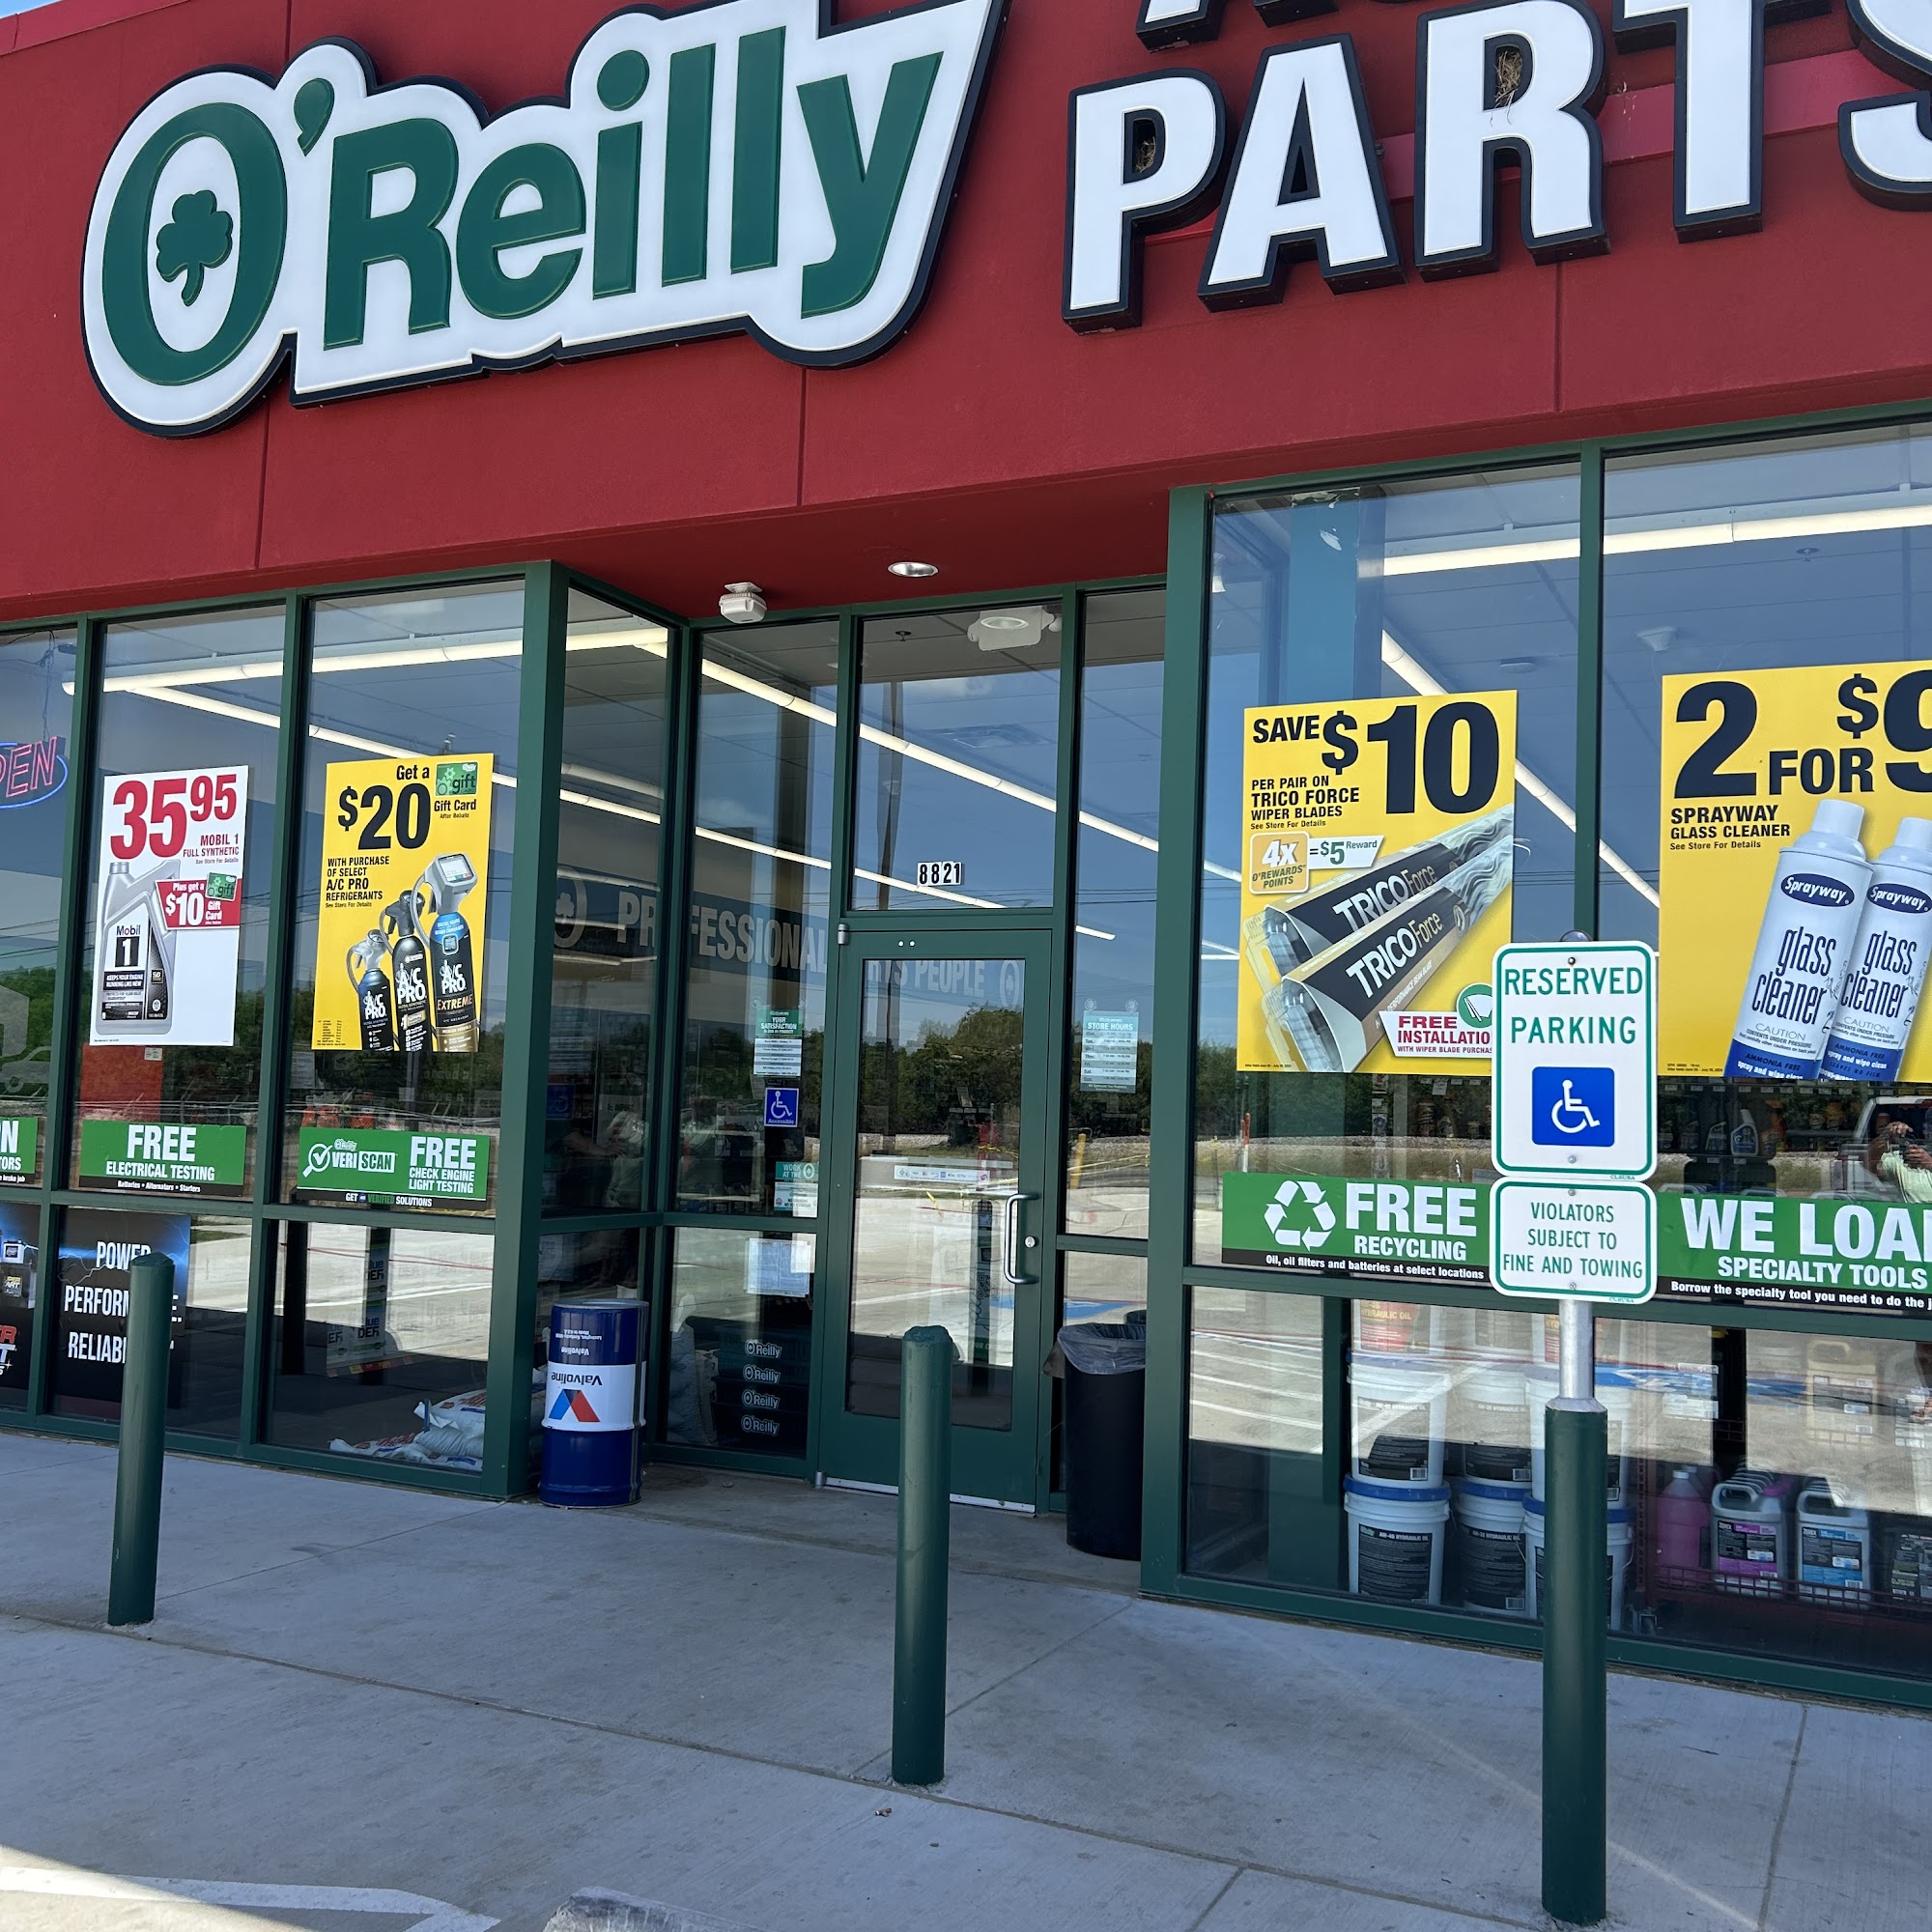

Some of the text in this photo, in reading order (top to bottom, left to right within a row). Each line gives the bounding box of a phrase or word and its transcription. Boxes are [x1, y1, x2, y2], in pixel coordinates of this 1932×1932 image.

[102, 26, 943, 386] O'Reilly
[1253, 715, 1321, 744] SAVE
[1674, 680, 1874, 799] 2 FOR
[396, 764, 430, 783] Get a
[1252, 775, 1329, 791] PER PAIR ON
[434, 799, 477, 812] Gift Card
[1252, 787, 1360, 809] TRICO FORCE
[338, 782, 432, 851] $20
[1251, 805, 1343, 821] WIPER BLADES
[1671, 804, 1778, 824] SPRAYWAY
[1300, 819, 1326, 828] Details
[1670, 823, 1790, 839] GLASS CLEANER
[200, 833, 239, 846] MOBIL 1
[1346, 840, 1378, 849] Reward
[1670, 839, 1761, 850] See Store For Details
[183, 846, 240, 858] FULL SYNTHETIC
[327, 855, 389, 867] WITH PURCHASE
[327, 867, 367, 878] OF SELECT
[919, 862, 961, 885] 8821
[1252, 865, 1304, 882] O'REWARDS
[173, 882, 187, 892] Plus
[326, 878, 369, 892] A/C PRO
[1263, 875, 1293, 890] POINTS
[1784, 875, 1847, 907] Sprayway
[326, 890, 383, 901] REFRIGERANTS
[1870, 885, 1927, 914] Sprayway
[165, 893, 205, 926] $10
[205, 910, 222, 921] Card
[117, 924, 141, 936] Mobil
[123, 938, 131, 966] 1
[1777, 926, 1836, 976] glass
[1861, 929, 1917, 976] glass
[441, 978, 467, 994] PRO
[1504, 966, 1643, 996] RESERVED
[397, 983, 426, 1005] PRO
[437, 994, 473, 1010] EXTREME
[1751, 973, 1828, 1025] cleaner
[1840, 970, 1909, 1018] cleaner
[365, 1005, 386, 1020] PRO
[1110, 1022, 1134, 1031] HOURS
[1399, 1016, 1458, 1029] FREE
[1511, 1016, 1636, 1044] PARKING
[1756, 1022, 1806, 1041] CAUTION
[1844, 1016, 1889, 1032] CAUTION
[1398, 1030, 1492, 1044] INSTALLATIO
[1745, 1053, 1784, 1068] AMMONIA
[127, 1124, 197, 1162] FREE
[410, 1136, 477, 1170] FREE
[106, 1160, 214, 1181] ELECTRICAL TESTING
[409, 1166, 475, 1182] CHECK ENGINE
[118, 1180, 201, 1193] Batteries Alternators Starters
[409, 1179, 474, 1194] LIGHT TESTING
[345, 1192, 358, 1203] GET
[395, 1196, 433, 1207] SOLUTIONS
[1346, 1182, 1477, 1237] FREE
[1530, 1202, 1614, 1223] VIOLATORS
[1527, 1228, 1617, 1250] SUBJECT TO
[1680, 1197, 1932, 1263] WE LOA
[1354, 1235, 1466, 1261] RECYCLING
[1265, 1254, 1485, 1280] Oil, oil filters and batteries at select locations
[1503, 1253, 1643, 1279] FINE AND TOWING
[1718, 1256, 1927, 1290] SPECIALTY TOOLS
[1671, 1281, 1924, 1308] Borrow the specialty tool you need to do the
[1400, 1311, 1411, 1321] OIL
[746, 1339, 781, 1358] O'Reilly
[551, 1371, 603, 1386] Valvoline
[743, 1364, 781, 1384] O'Reilly
[742, 1389, 780, 1409] O'Reilly
[741, 1414, 780, 1435] O'Reilly
